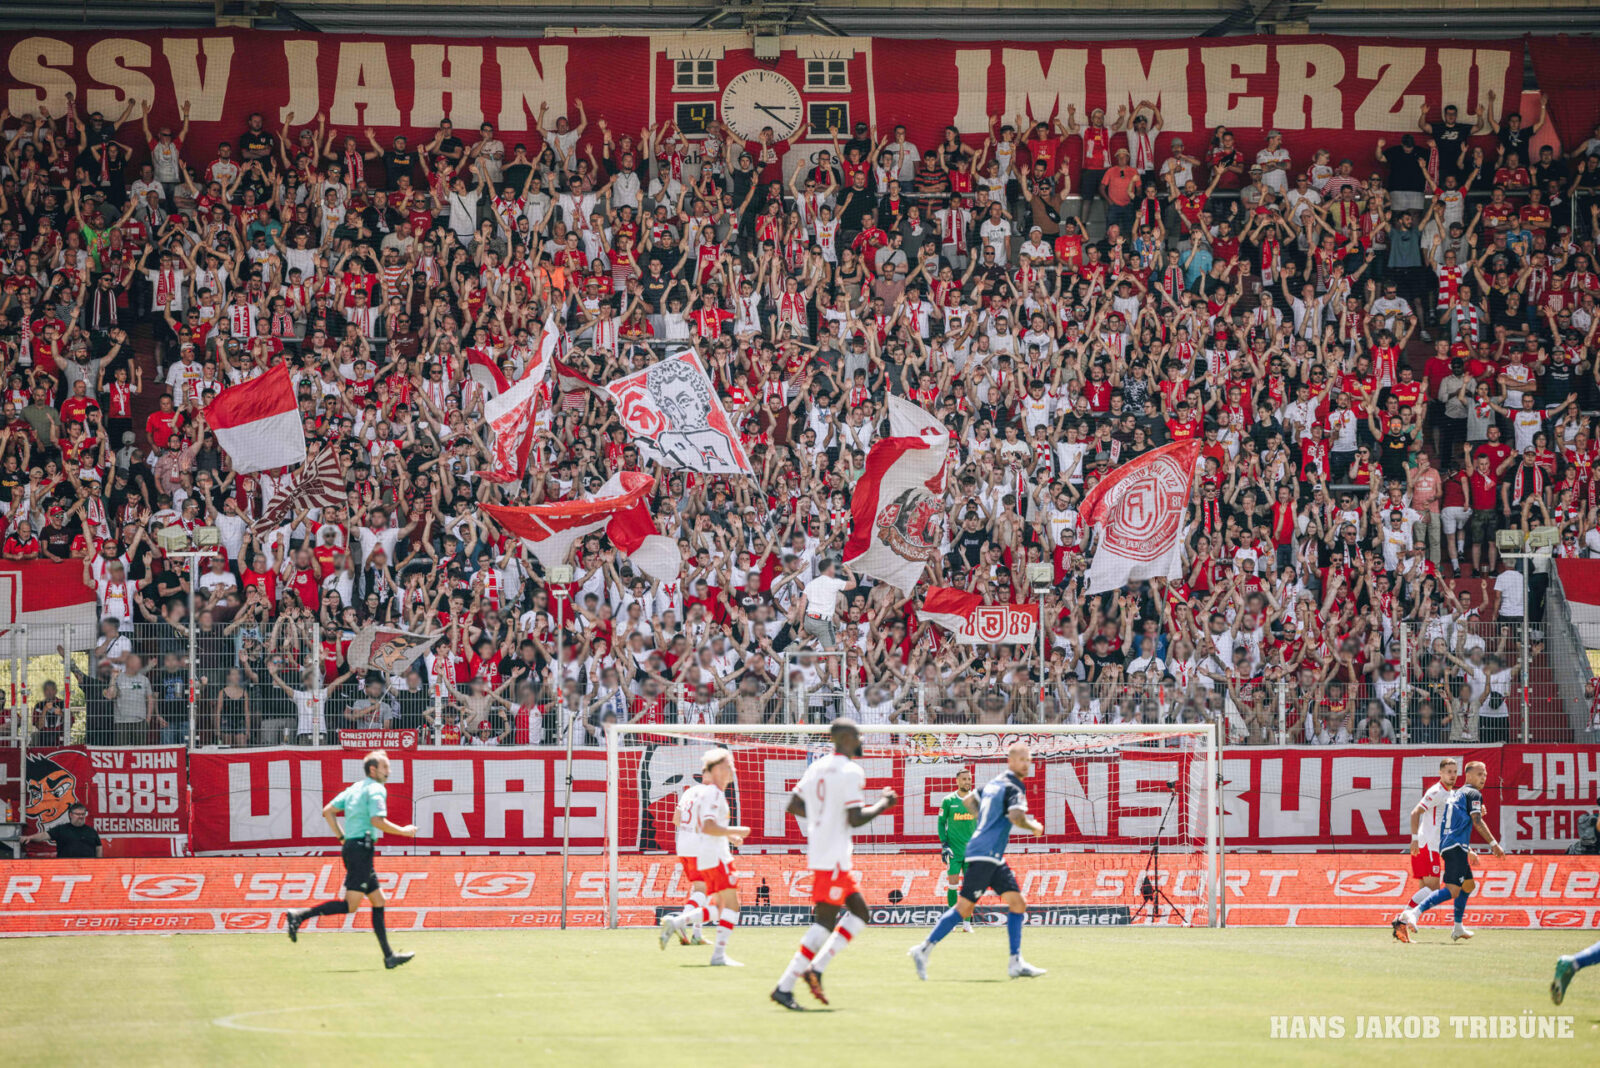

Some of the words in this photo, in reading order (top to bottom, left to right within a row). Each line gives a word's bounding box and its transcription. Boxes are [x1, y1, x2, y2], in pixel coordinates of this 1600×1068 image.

[8, 36, 234, 122] SSV
[280, 39, 568, 131] JAHN
[953, 43, 1511, 135] IMMERZU
[691, 108, 706, 130] 4
[73, 407, 86, 415] Nett
[341, 731, 382, 739] CHRISTOPH
[384, 731, 399, 739] FÜR
[91, 752, 124, 768] SSV
[131, 752, 177, 768] JAHN
[92, 773, 178, 813] 1889
[93, 818, 179, 832] REGENSBURG
